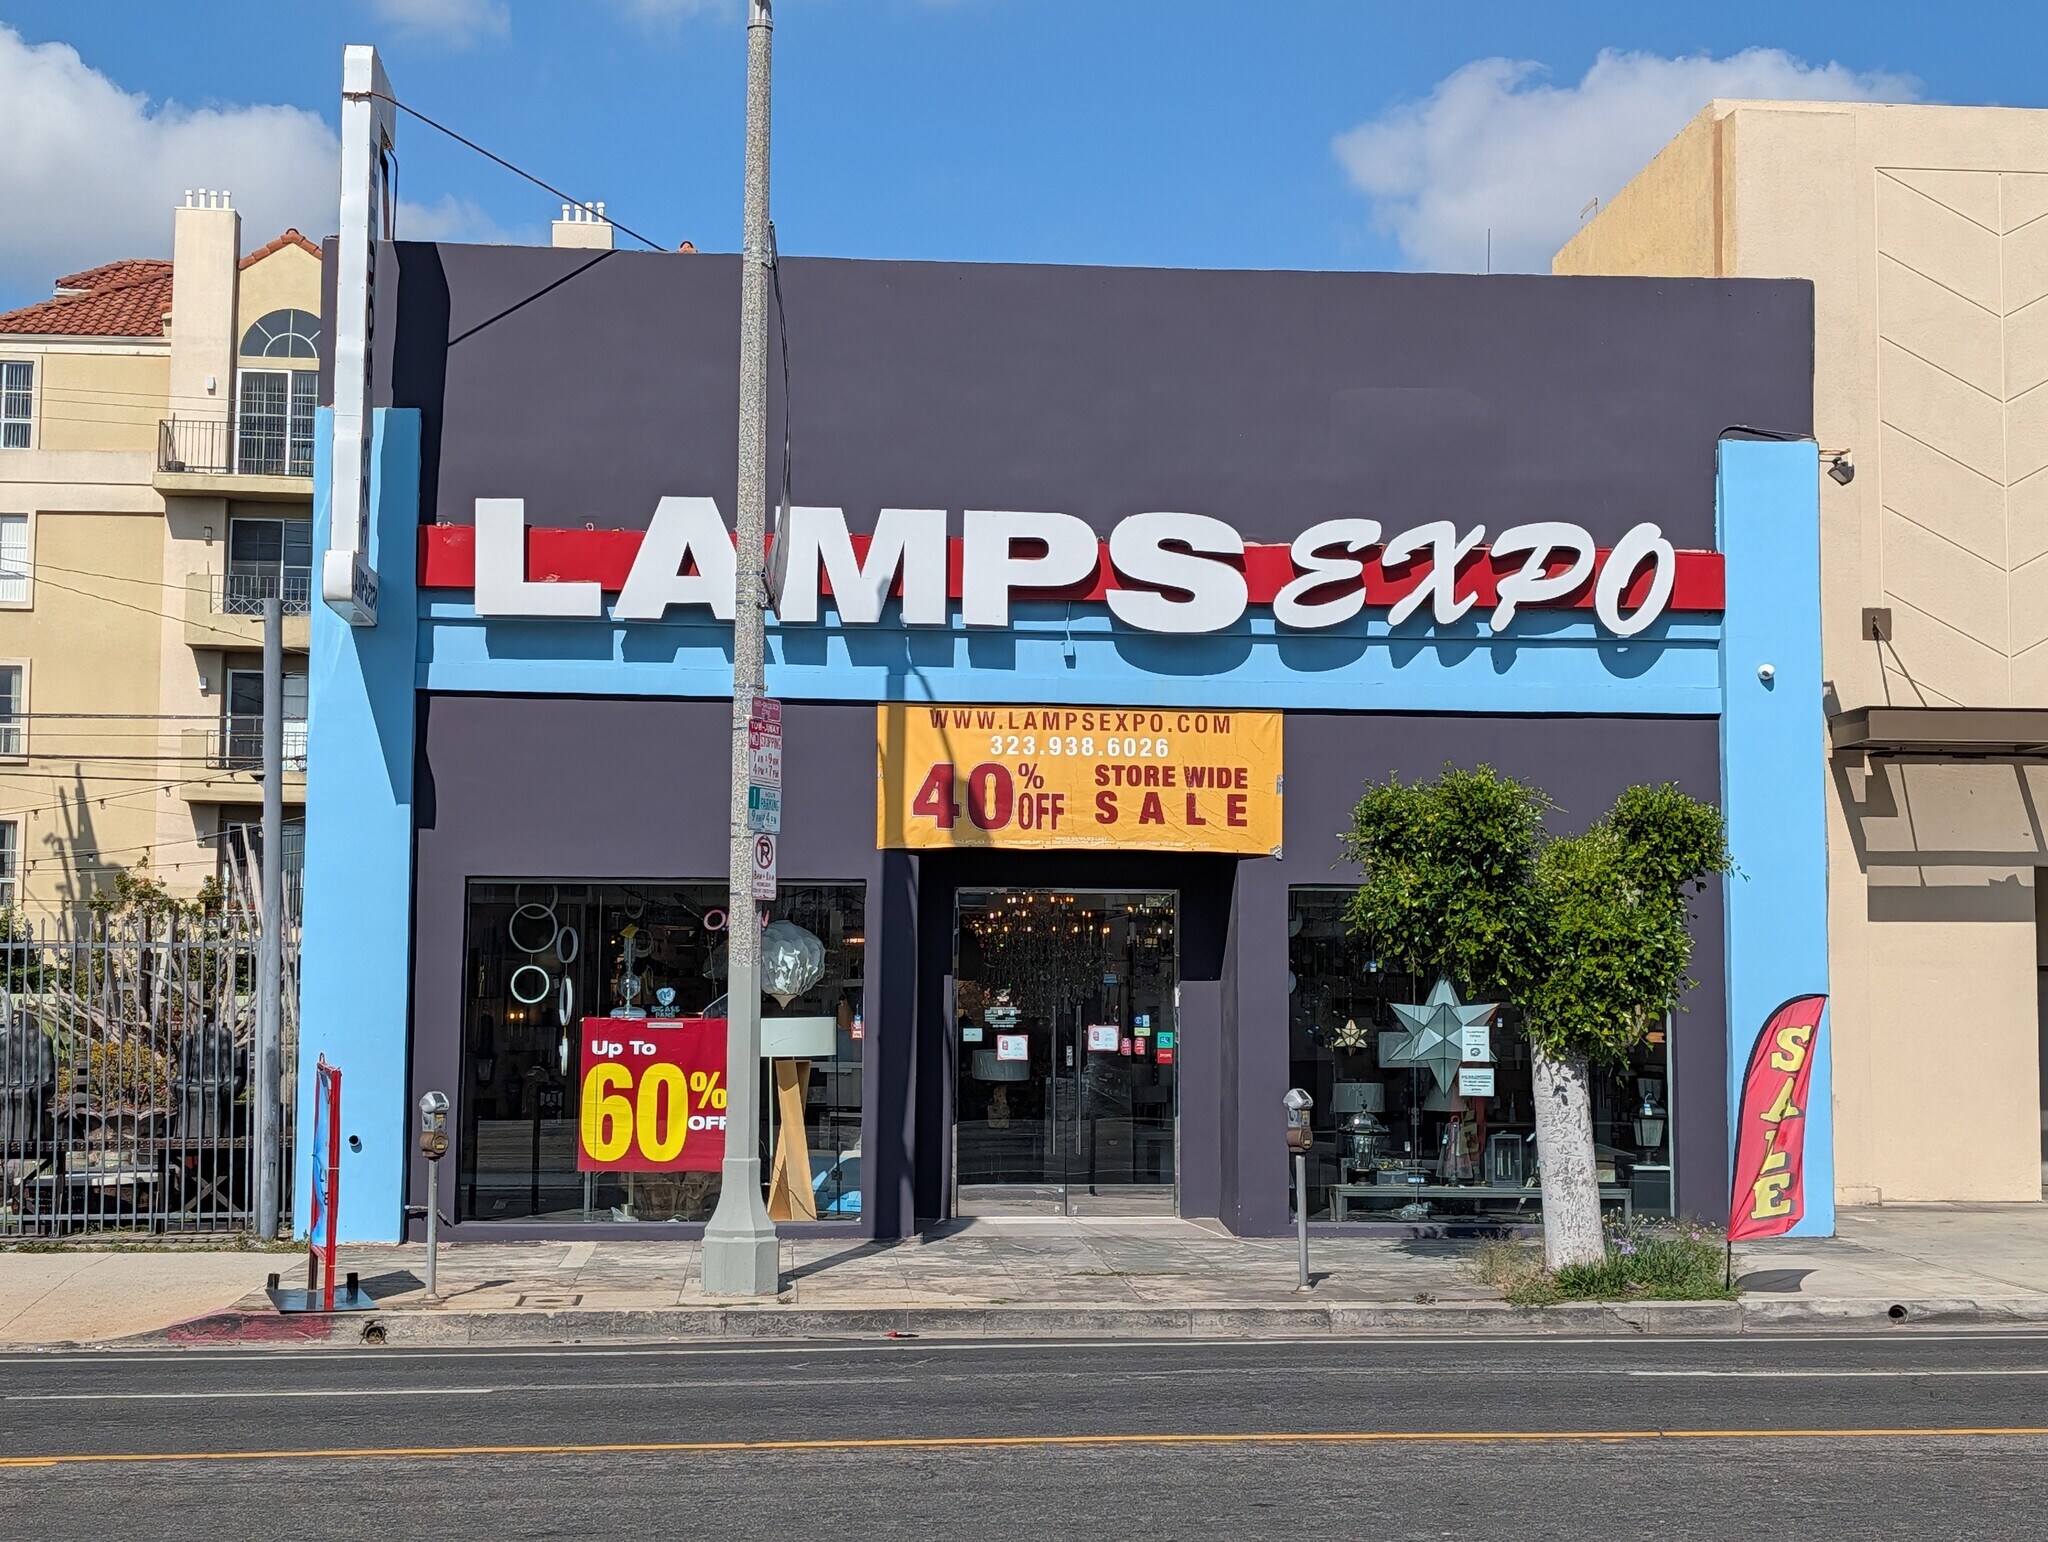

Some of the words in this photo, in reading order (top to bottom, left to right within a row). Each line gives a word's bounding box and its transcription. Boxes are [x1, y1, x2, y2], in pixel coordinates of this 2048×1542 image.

[474, 495, 1249, 633] LAMPS
[1272, 517, 1676, 636] EXPO
[929, 708, 1231, 734] WWW.LAMPSEXPO.COM
[990, 735, 1169, 758] 323.938.6026
[1094, 764, 1176, 788] STORE
[1185, 766, 1248, 790] WIDE
[1017, 793, 1065, 831] OFF
[1095, 790, 1248, 827] SALE
[591, 1040, 624, 1059] Up
[628, 1040, 657, 1056] To
[1750, 1025, 1814, 1220] SALE
